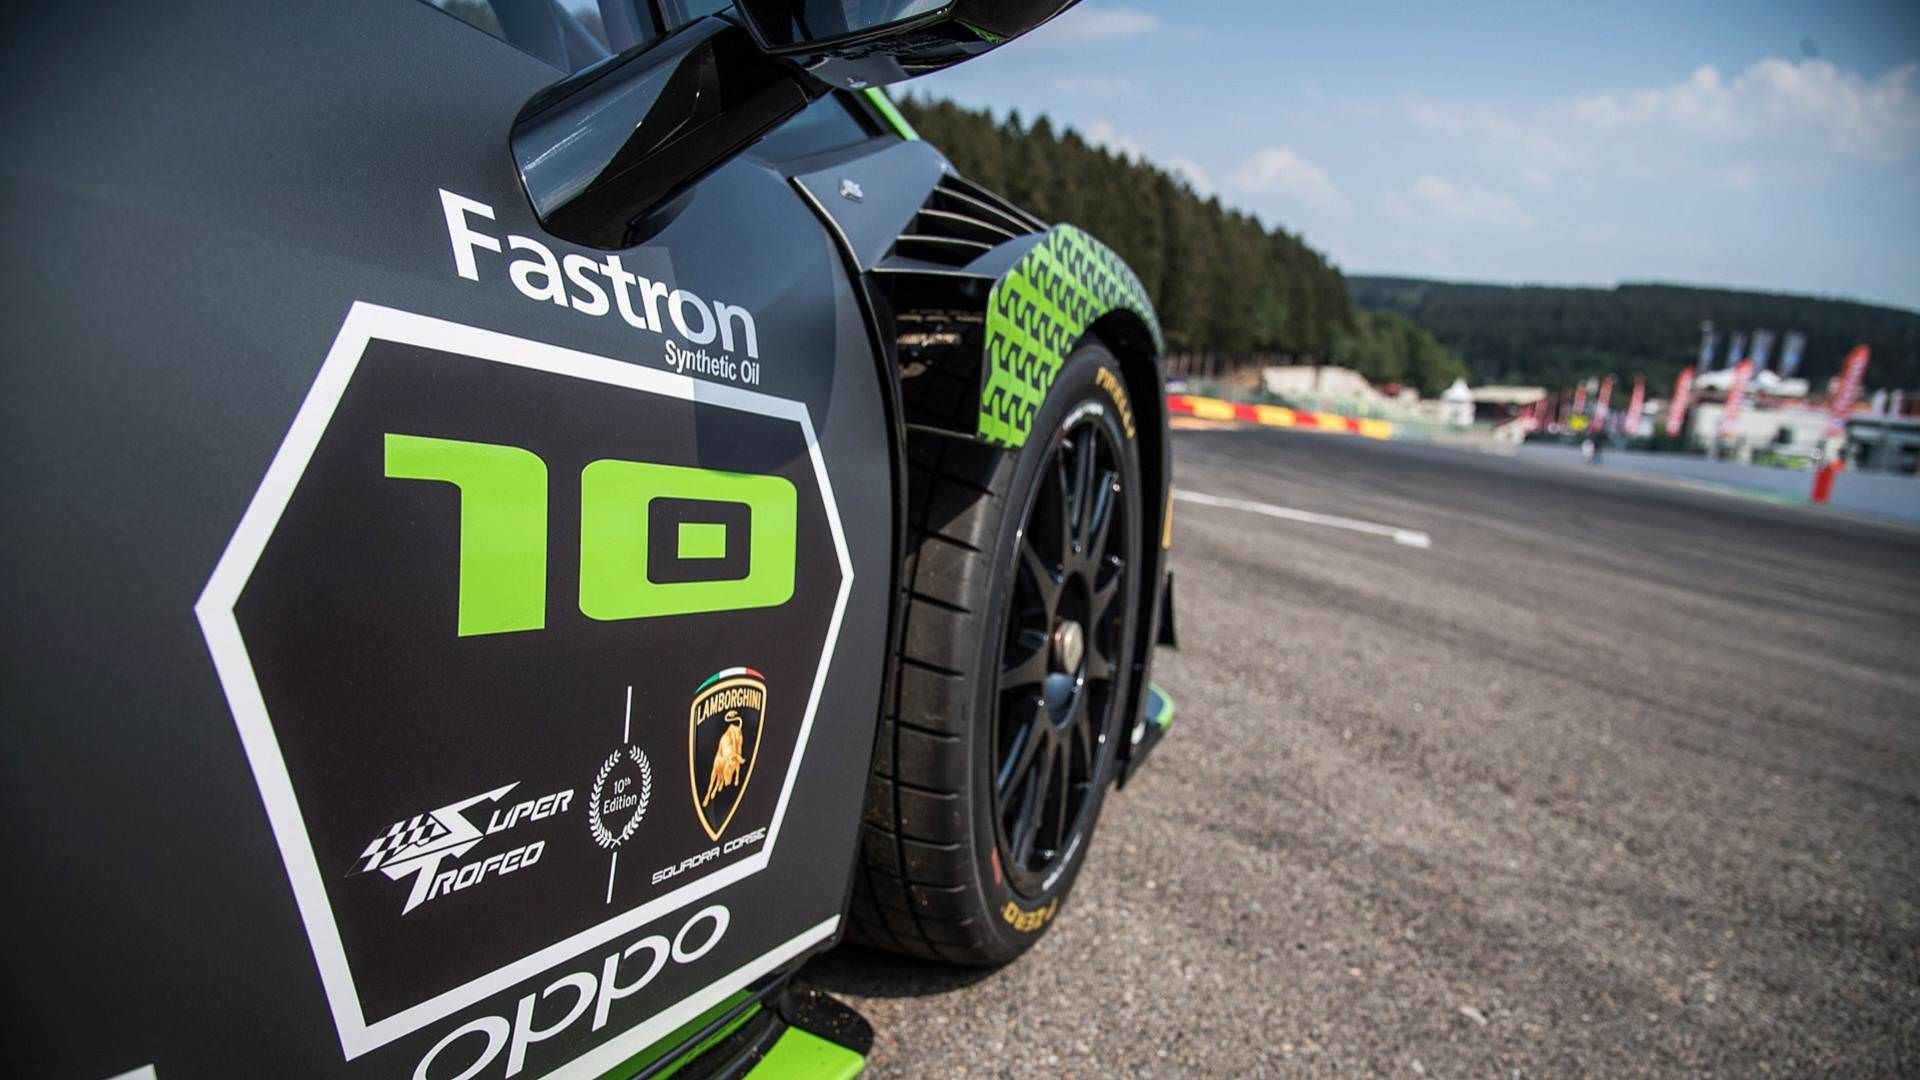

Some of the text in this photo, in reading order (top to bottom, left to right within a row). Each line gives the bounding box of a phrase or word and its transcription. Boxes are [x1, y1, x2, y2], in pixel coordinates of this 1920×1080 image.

[438, 188, 759, 359] Fastron
[665, 339, 760, 386] Synthetic Oil
[384, 432, 798, 638] 10
[696, 687, 762, 726] LAMBORGHINI
[603, 794, 637, 815] Edition
[613, 776, 632, 795] 10th
[379, 836, 546, 917] TROFEO
[651, 827, 767, 885] SQUADRA CORSE
